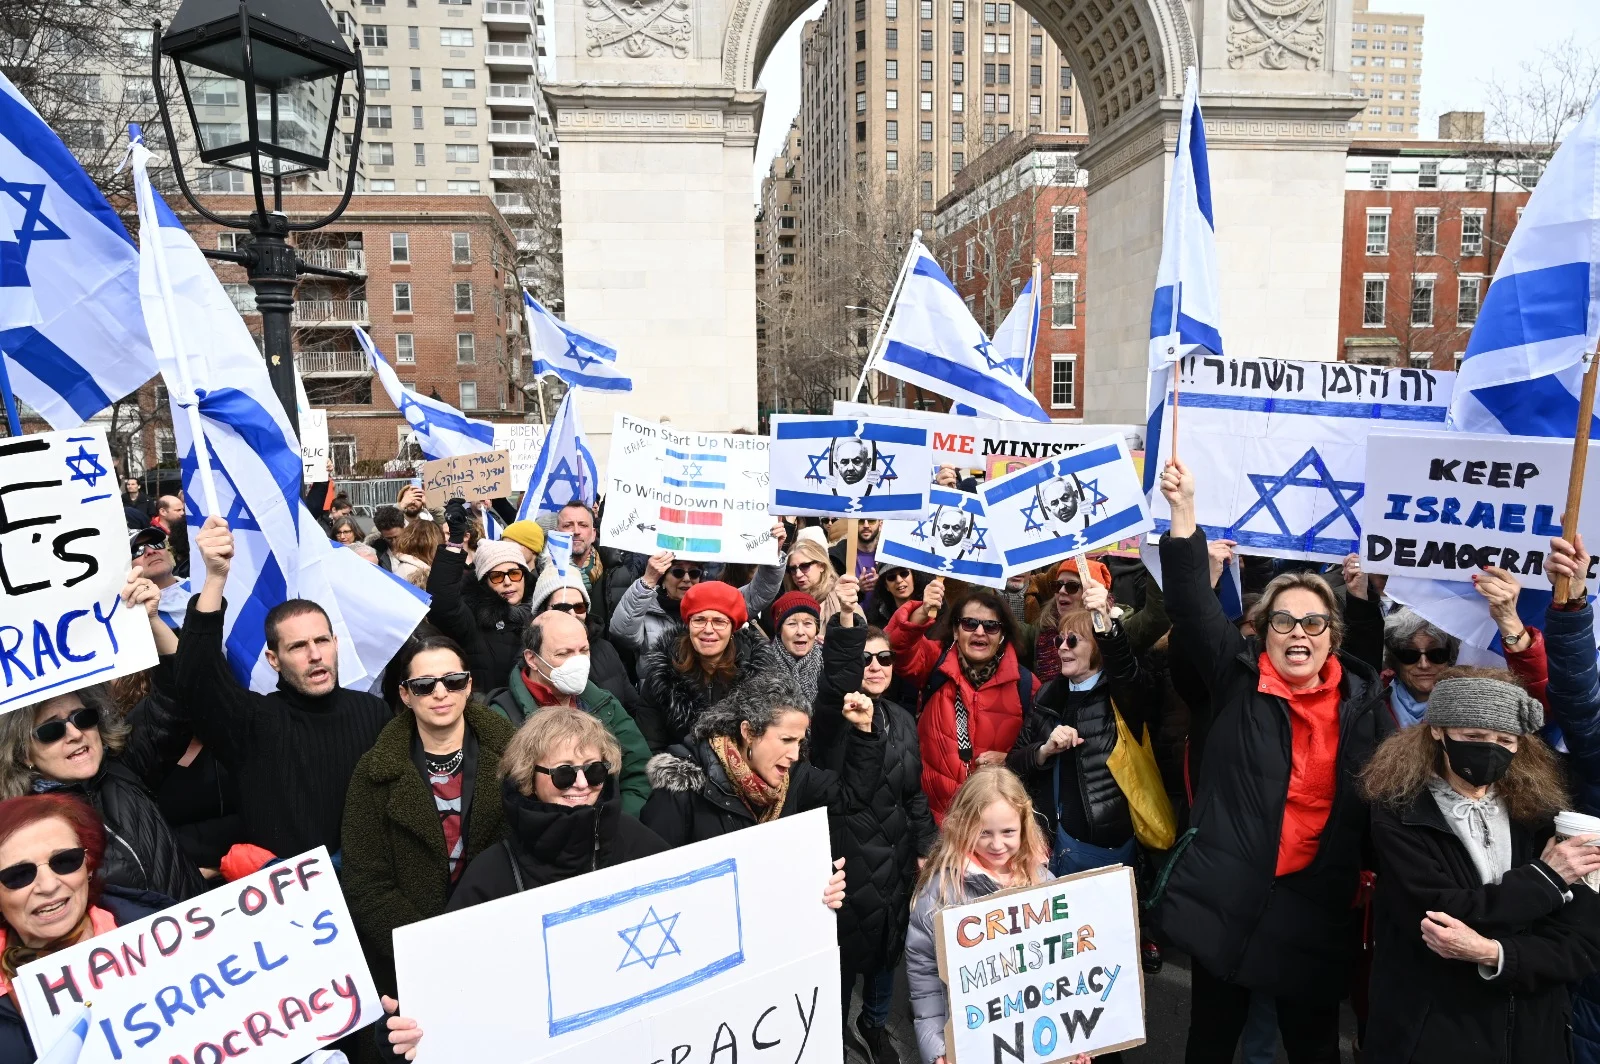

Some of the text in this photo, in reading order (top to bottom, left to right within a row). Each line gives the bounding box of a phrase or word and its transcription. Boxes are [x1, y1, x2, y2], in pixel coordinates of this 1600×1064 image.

[1400, 369, 1437, 402] זה
[510, 425, 540, 437] BIDEN
[622, 416, 657, 438] From
[660, 429, 691, 447] Start
[697, 435, 719, 450] Up
[613, 478, 632, 494] To
[635, 483, 672, 504] Wind
[674, 494, 718, 509] Down
[1428, 458, 1542, 489] KEEP
[1384, 493, 1563, 537] ISRAEL
[36, 857, 323, 1017] HANDS-OFF
[956, 893, 1069, 949] CRIME
[958, 923, 1097, 994] MINISTER
[964, 964, 1122, 1030] DEMOCRACY
[992, 1006, 1105, 1064] NOW
